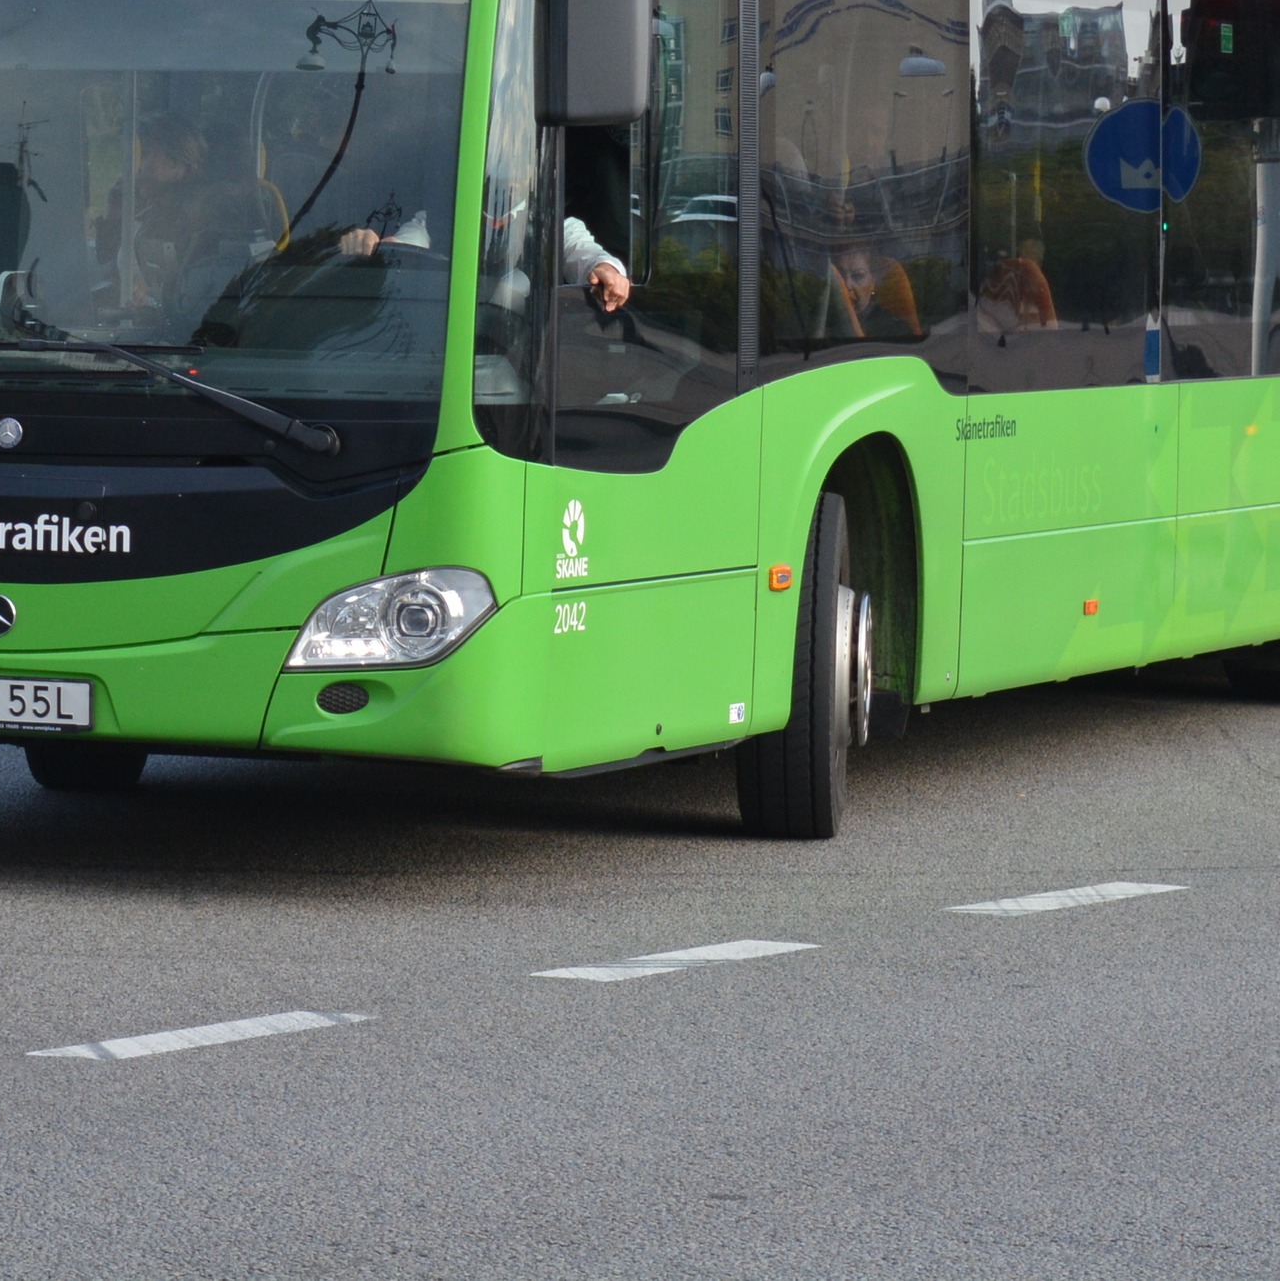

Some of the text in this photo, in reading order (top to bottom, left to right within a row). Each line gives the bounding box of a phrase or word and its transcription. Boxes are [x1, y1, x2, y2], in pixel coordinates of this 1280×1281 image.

[955, 414, 1017, 441] Skånetrafiken
[554, 601, 586, 634] 2042
[9, 684, 73, 719] 55L
